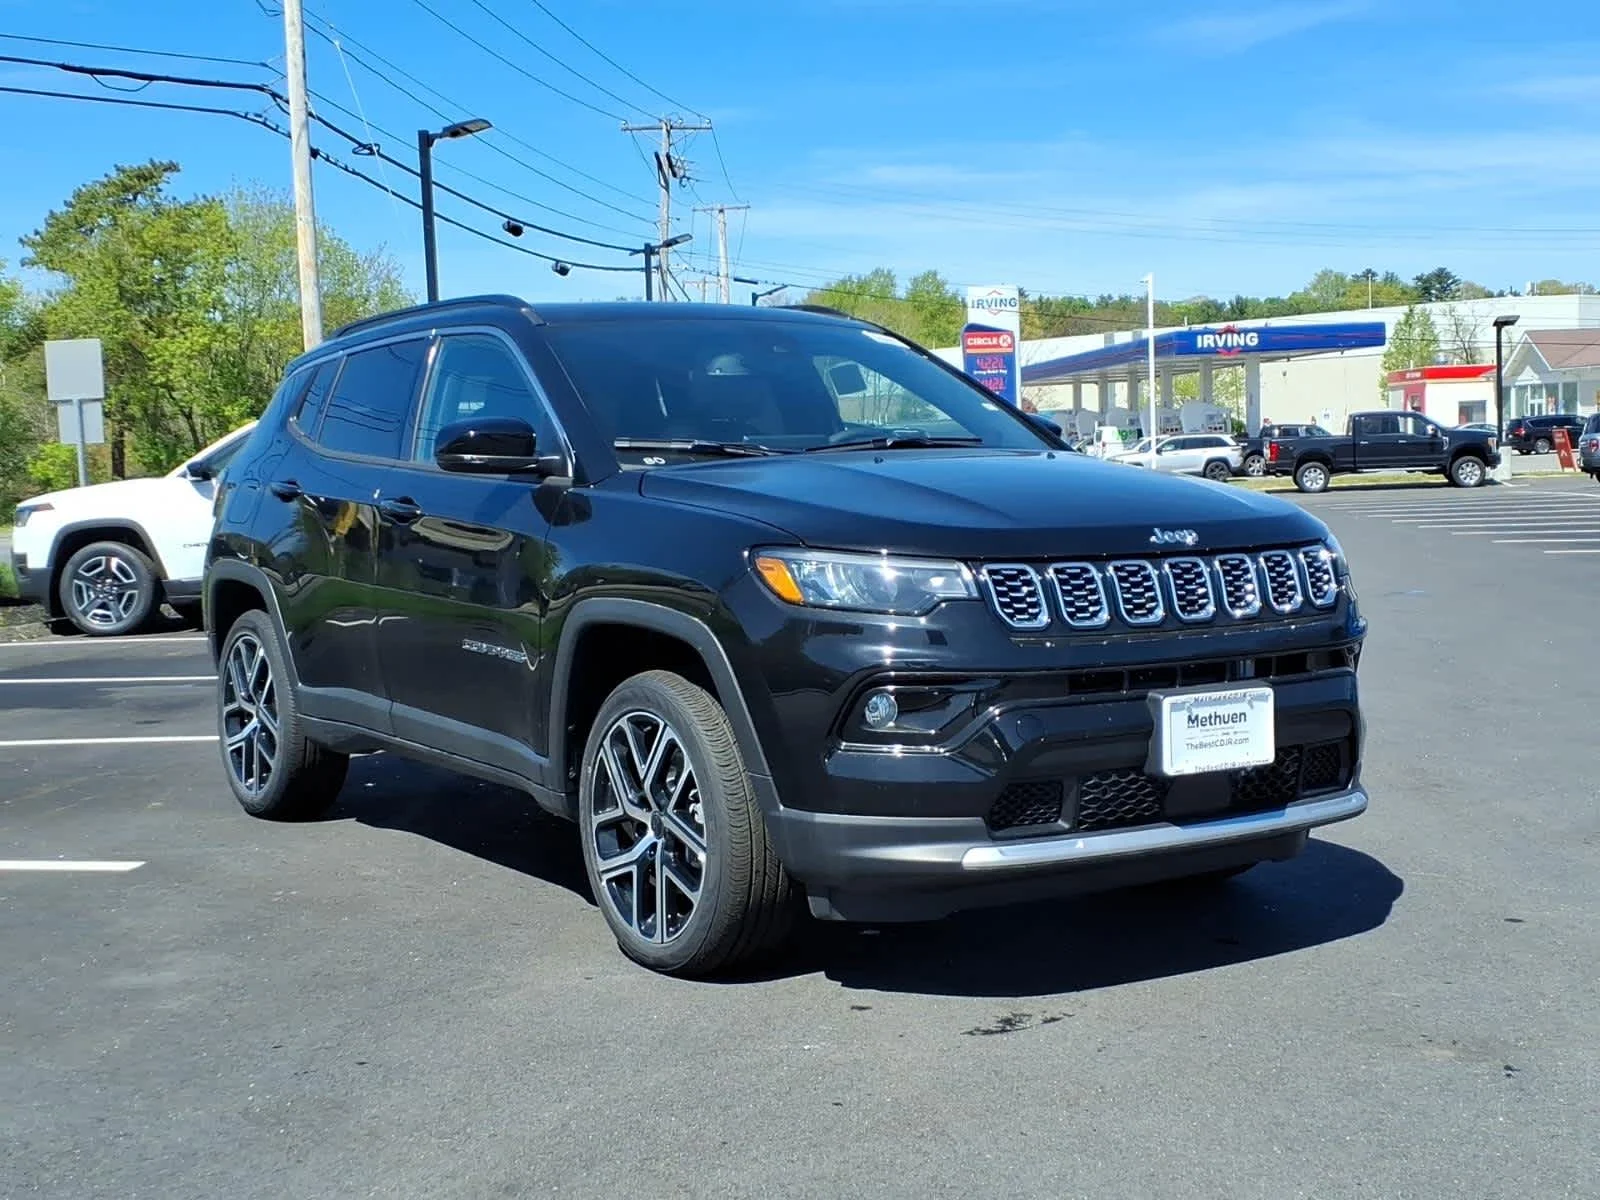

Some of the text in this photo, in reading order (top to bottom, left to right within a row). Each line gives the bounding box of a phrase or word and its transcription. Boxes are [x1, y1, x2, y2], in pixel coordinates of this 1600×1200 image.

[971, 297, 1017, 309] IRVING
[967, 337, 998, 346] CIRCLE
[1197, 332, 1258, 348] IRVING
[1150, 527, 1199, 546] Jeep
[1187, 711, 1247, 729] Methuen
